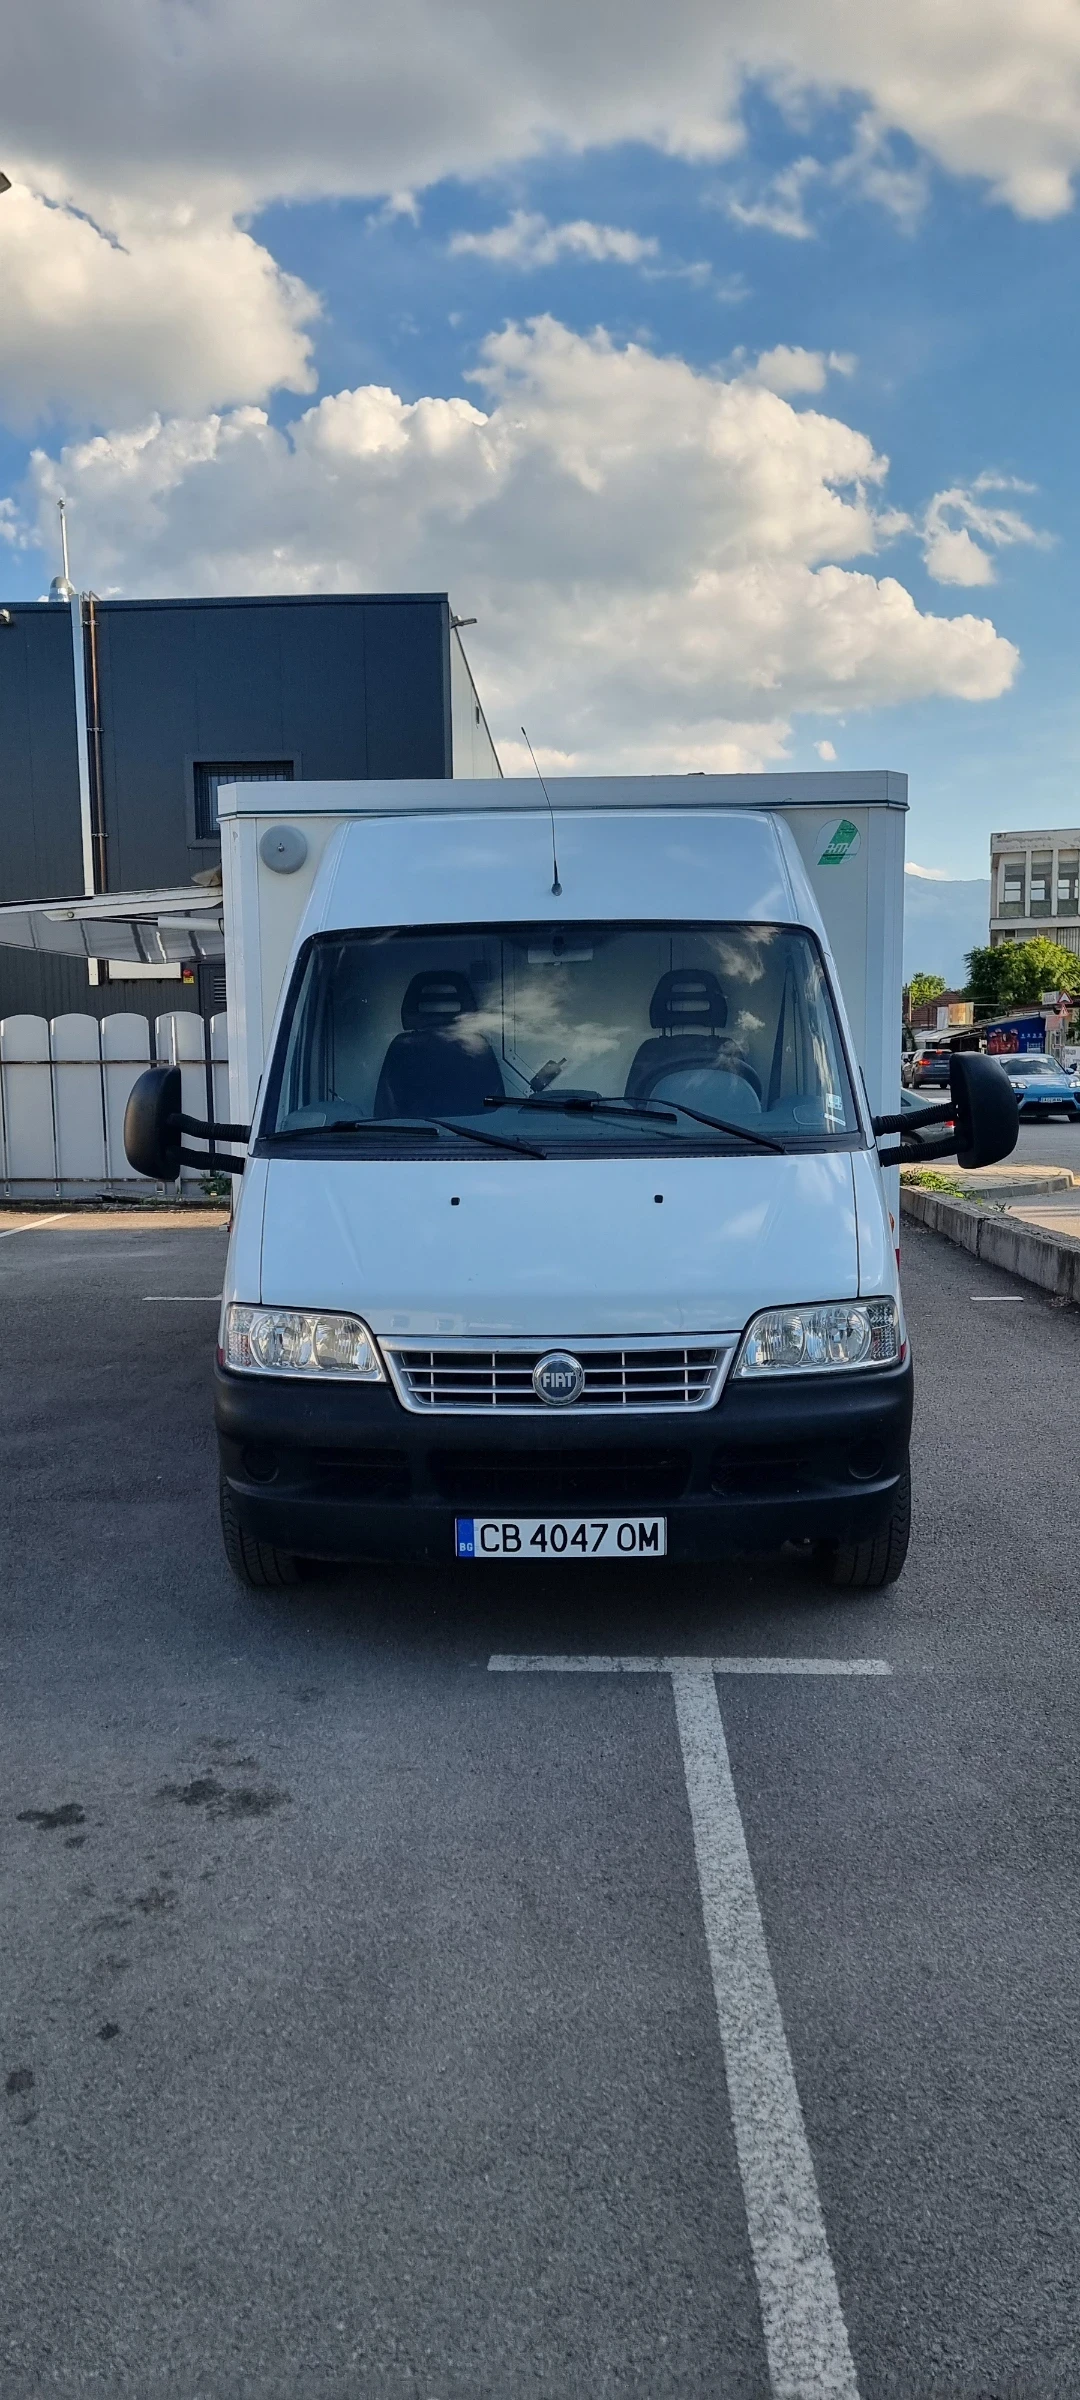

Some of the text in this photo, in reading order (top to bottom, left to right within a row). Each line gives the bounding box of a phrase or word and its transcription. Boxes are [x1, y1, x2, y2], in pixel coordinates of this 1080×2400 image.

[542, 1372, 574, 1388] FIAT
[480, 1522, 659, 1553] CB 4047 OM
[459, 1542, 473, 1552] BG
